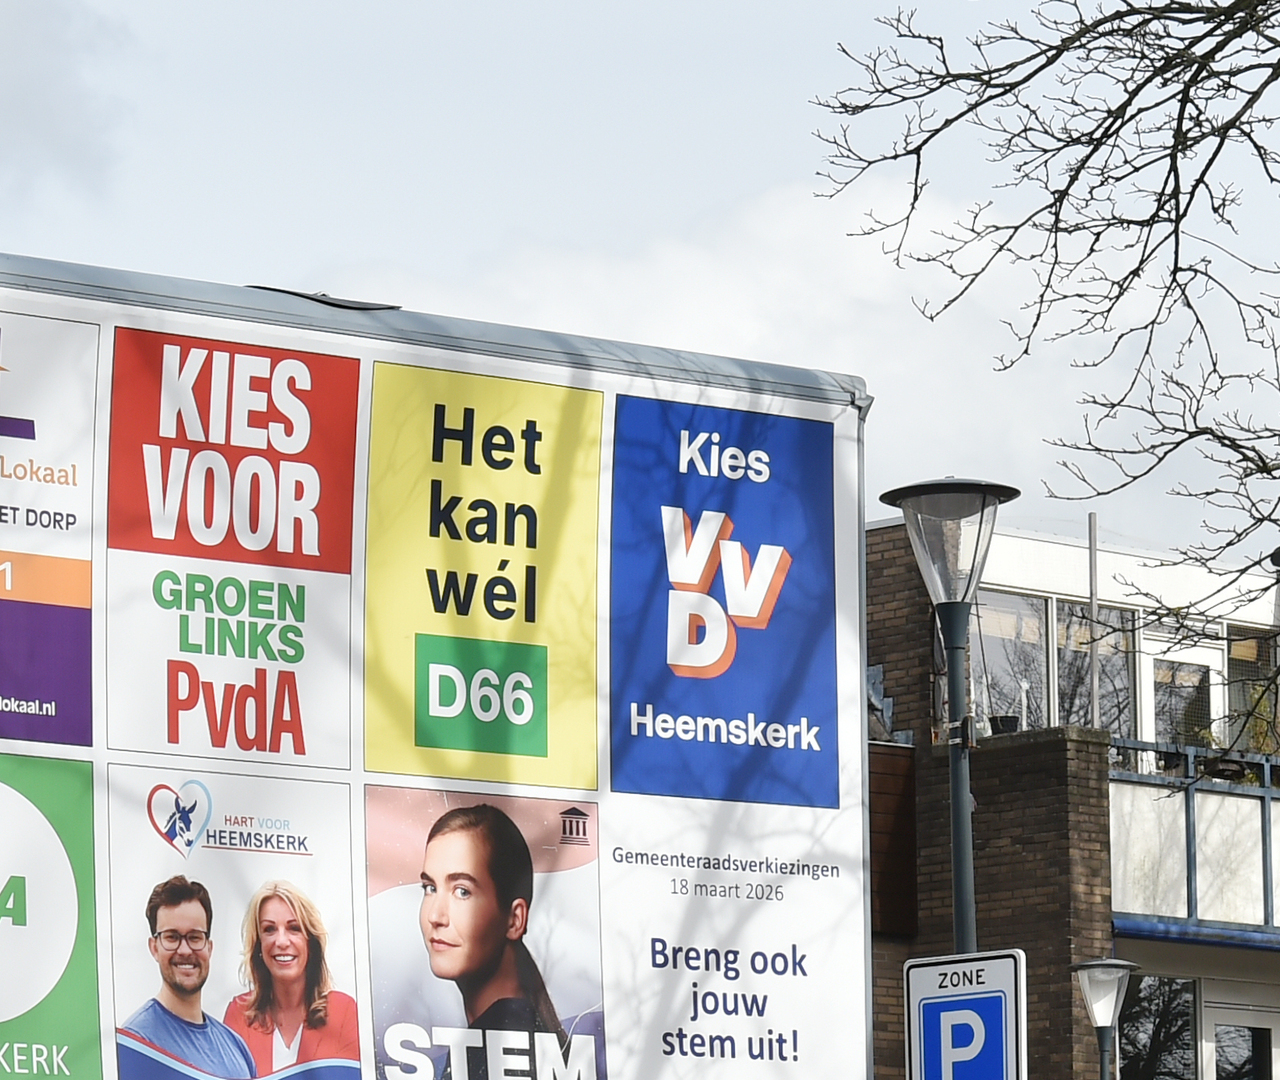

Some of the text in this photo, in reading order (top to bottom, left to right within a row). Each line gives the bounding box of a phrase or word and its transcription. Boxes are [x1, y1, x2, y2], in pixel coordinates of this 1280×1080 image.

[159, 344, 312, 455] KIES
[431, 403, 543, 475] Het
[678, 429, 771, 483] Kies
[0, 455, 78, 487] Lokaal
[25, 507, 77, 532] DORP
[142, 444, 320, 557] VOOR
[428, 479, 537, 549] kan
[152, 570, 306, 624] GROEN
[425, 559, 537, 624] wél
[179, 614, 305, 664] LINKS
[166, 659, 306, 756] PvdA
[428, 662, 534, 726] D66
[630, 702, 821, 751] Heemskerk
[205, 828, 309, 852] HEEMSKERK
[224, 814, 291, 831] HART VOOR
[612, 846, 840, 882] Gemeenteraadsverkiezingen
[670, 878, 784, 902] 18 maart 2026
[650, 937, 808, 980] Breng ook
[938, 968, 986, 989] ZONE
[690, 982, 768, 1021] jouw
[661, 1027, 800, 1062] stem uit!
